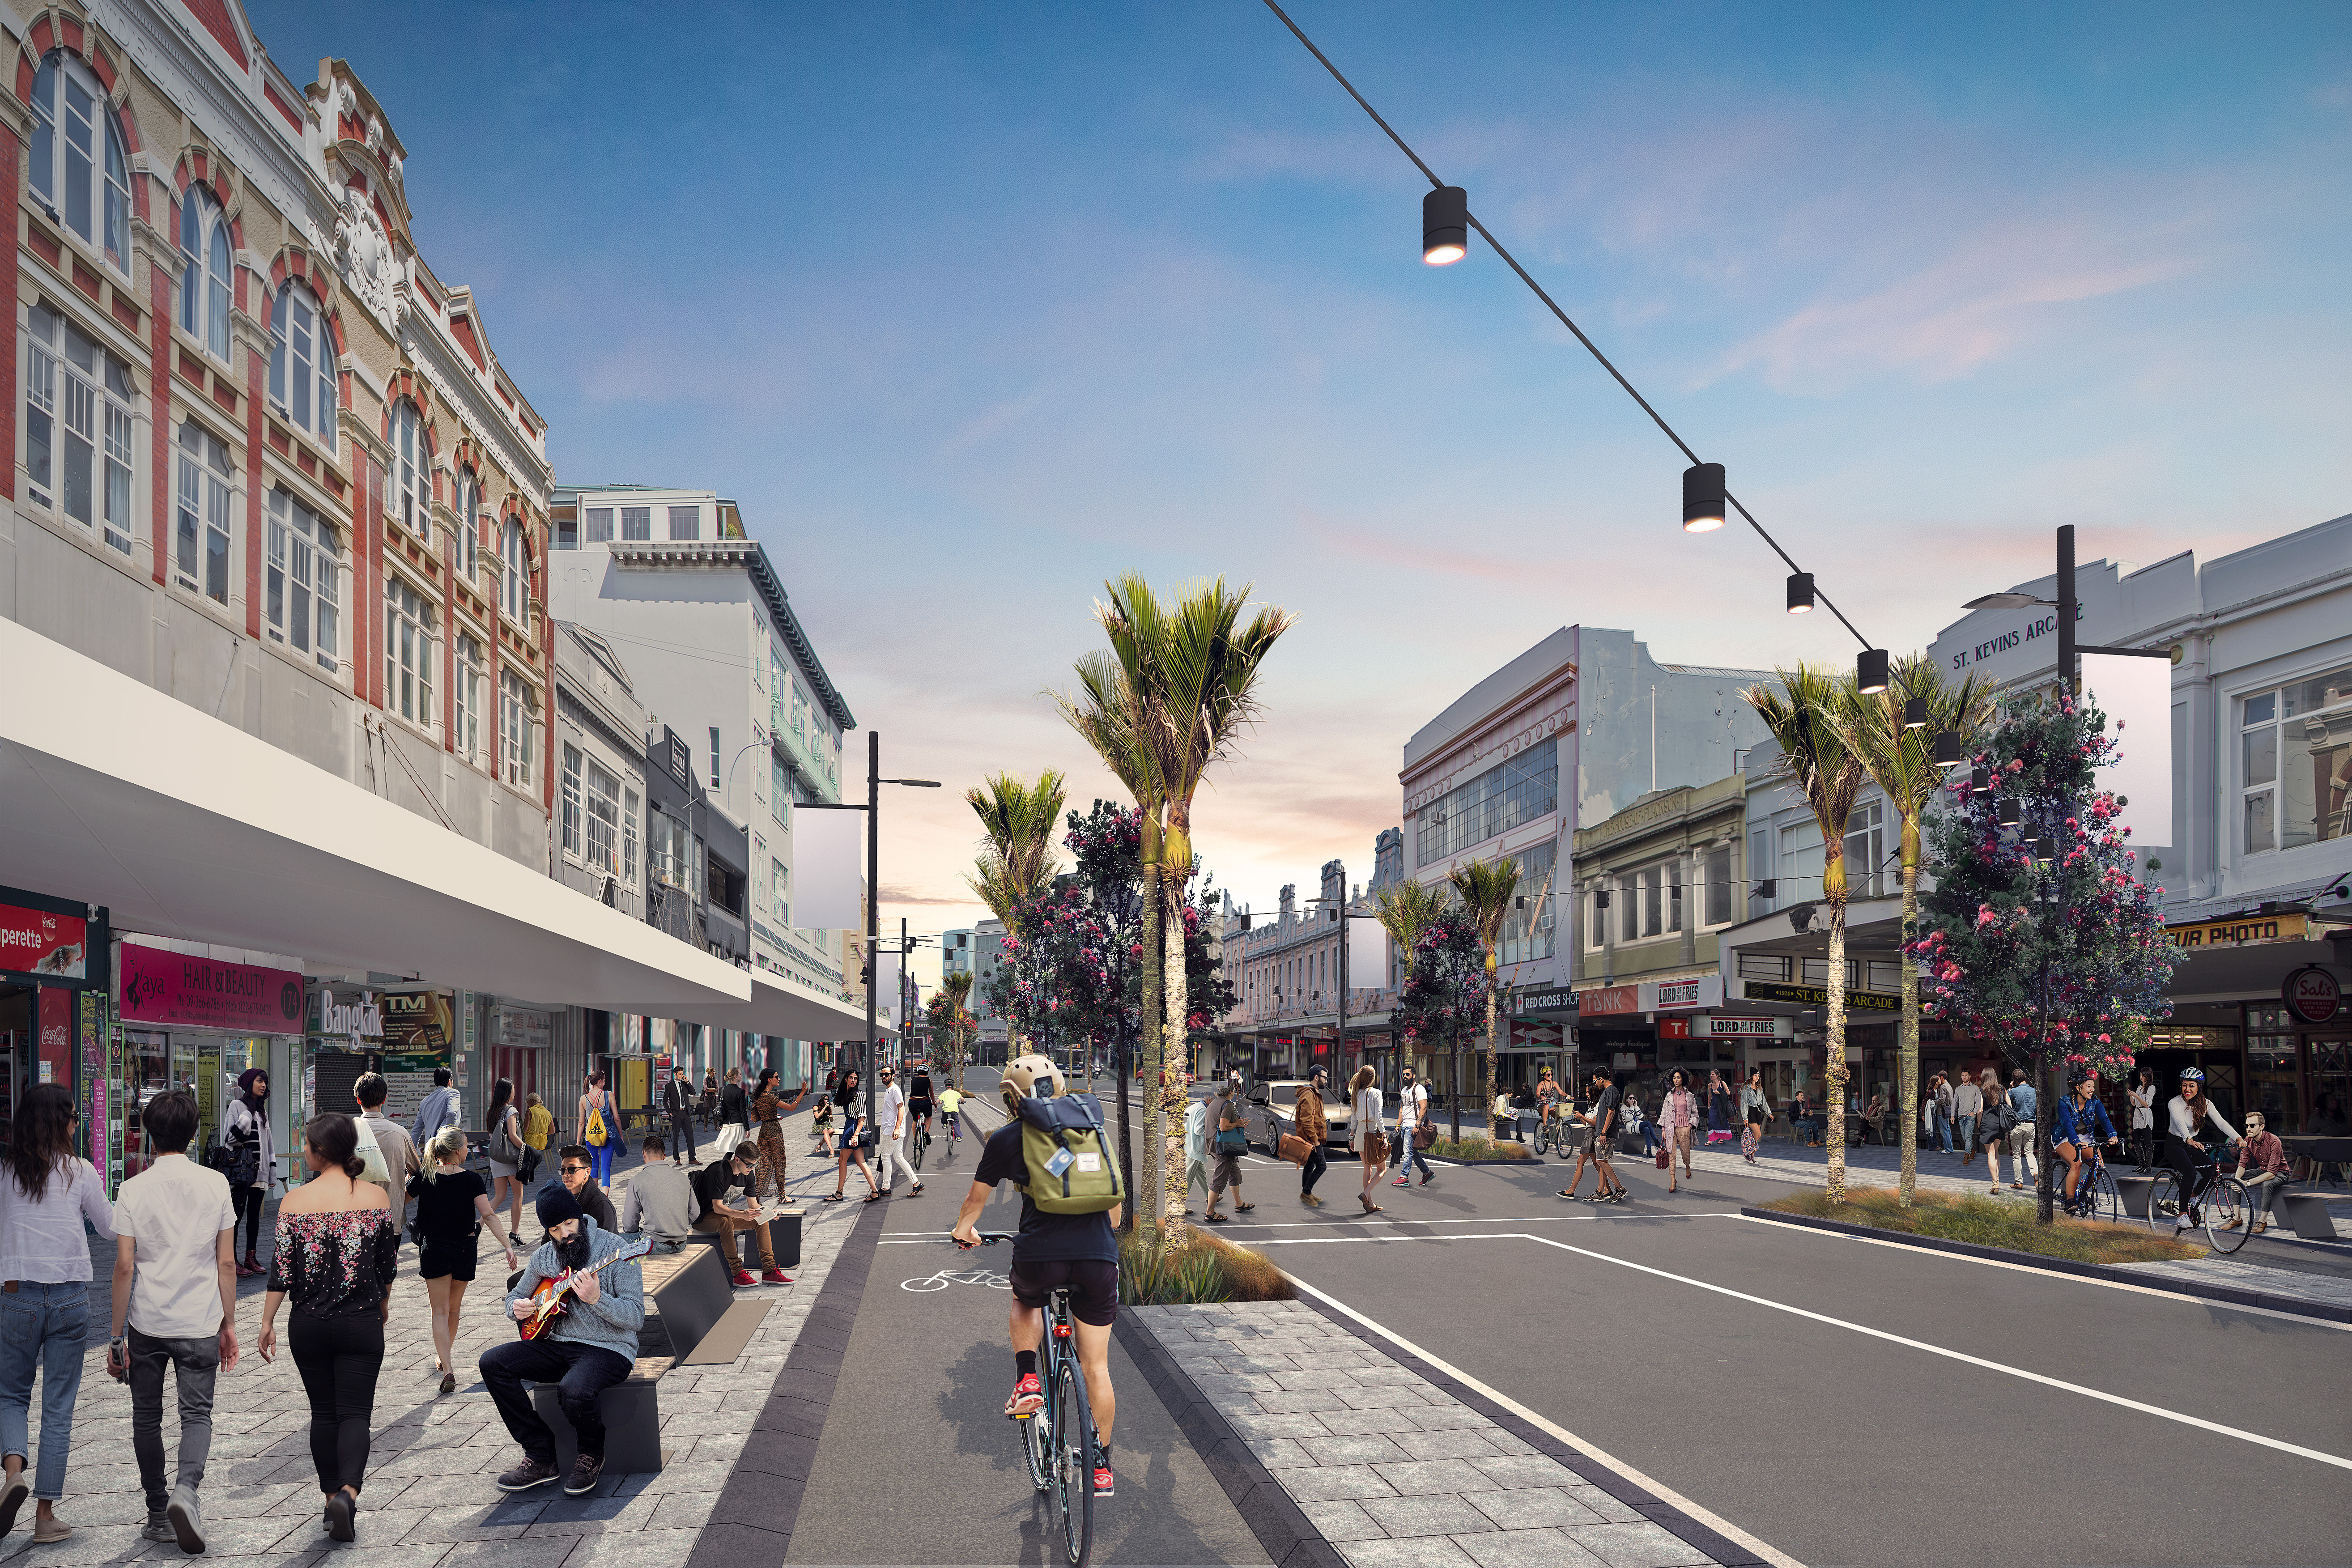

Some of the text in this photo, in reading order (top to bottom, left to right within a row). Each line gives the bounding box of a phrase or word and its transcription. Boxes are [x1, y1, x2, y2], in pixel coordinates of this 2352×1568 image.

[91, 0, 197, 115] NDELLS
[1953, 651, 1970, 670] ST.
[1975, 630, 2019, 662] KEVINS
[0, 928, 42, 949] perette
[184, 962, 265, 998] HAIR & BEAUTY
[2299, 979, 2332, 996] Sal's
[283, 990, 298, 1013] 174
[385, 995, 426, 1010] TM
[1526, 992, 1579, 1009] RED CROSS SHOP
[1659, 987, 1676, 1003] LORD
[1682, 985, 1699, 1001] FRIES
[1853, 995, 1894, 1008] ARCADE
[186, 994, 220, 1010] 09-366-6786
[226, 999, 238, 1012] Mob:
[239, 1001, 272, 1016] 022-675-0402
[321, 990, 384, 1050] Bangkok
[1711, 1020, 1739, 1033] LORD
[1749, 1021, 1774, 1033] FRIES
[1328, 1027, 1340, 1036] RAS
[1606, 1039, 1650, 1049] vintage boutique
